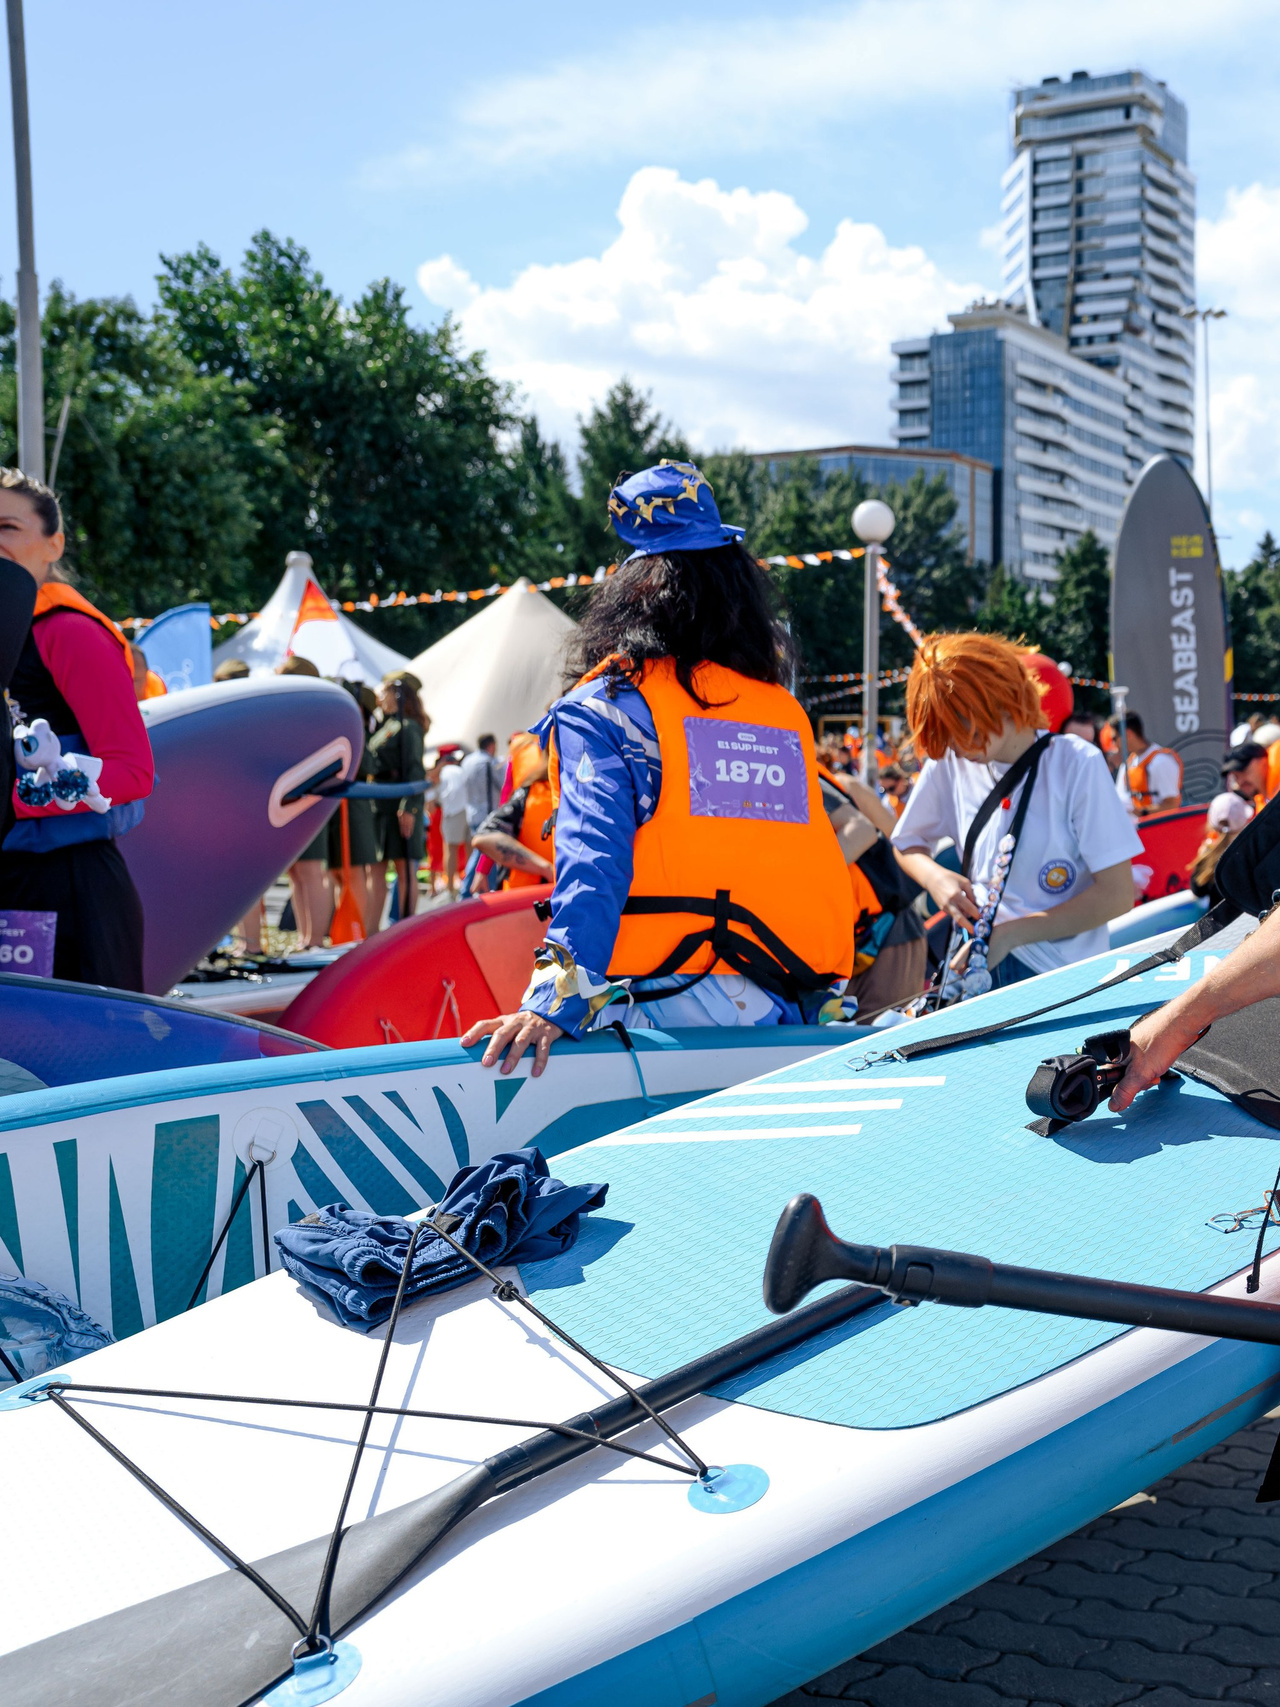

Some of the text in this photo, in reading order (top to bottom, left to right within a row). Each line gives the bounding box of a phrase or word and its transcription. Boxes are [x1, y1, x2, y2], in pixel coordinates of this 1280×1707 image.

[1169, 567, 1199, 733] SEABEAST
[717, 740, 779, 755] E1 SUP FEST
[715, 759, 786, 787] 1870
